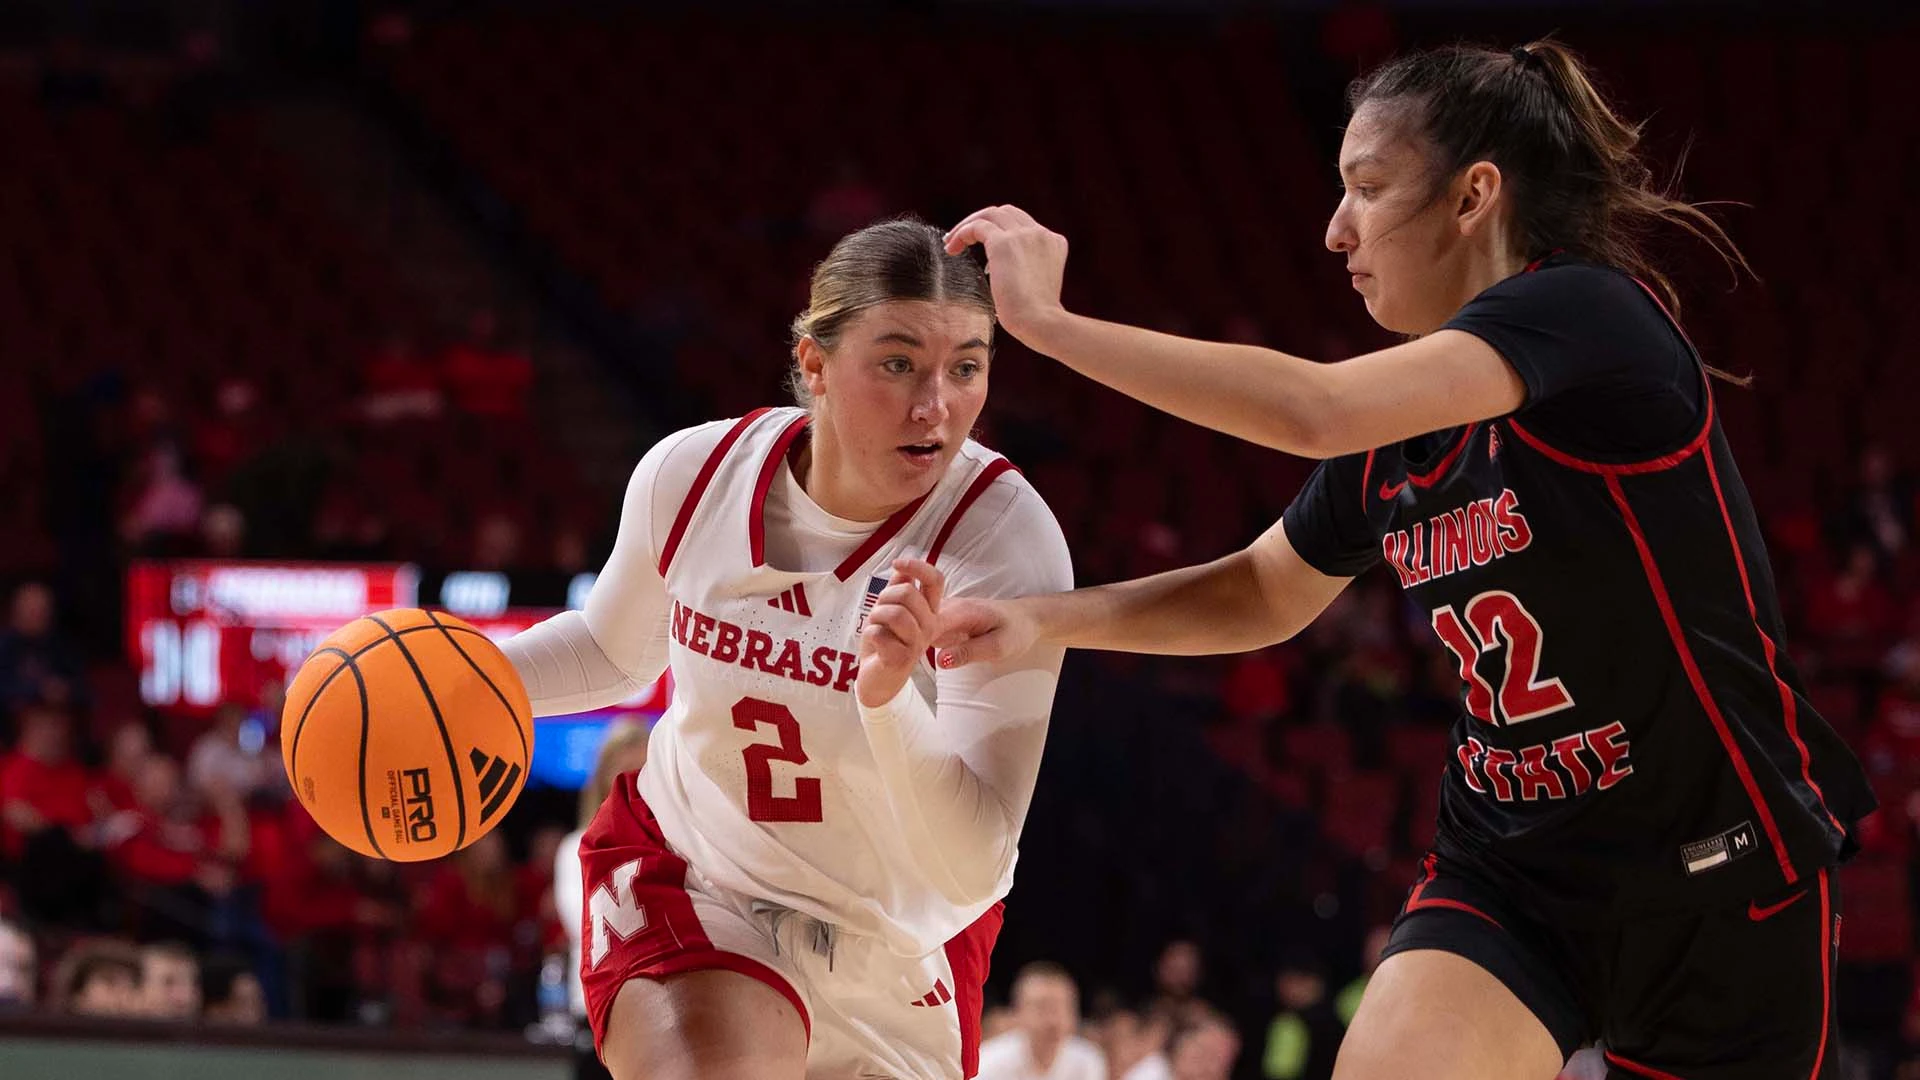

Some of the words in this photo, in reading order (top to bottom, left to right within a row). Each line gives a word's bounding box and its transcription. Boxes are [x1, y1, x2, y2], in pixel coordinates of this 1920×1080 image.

[1383, 488, 1533, 589] ILLINOIS
[671, 599, 861, 693] NEBRASK
[1432, 590, 1575, 727] 12
[387, 770, 399, 807] OFFICIAL
[731, 696, 823, 822] 2
[1457, 720, 1634, 801] STATE
[392, 808, 403, 829] GAME
[403, 768, 437, 842] PRO
[1734, 832, 1749, 850] M
[589, 858, 648, 972] N
